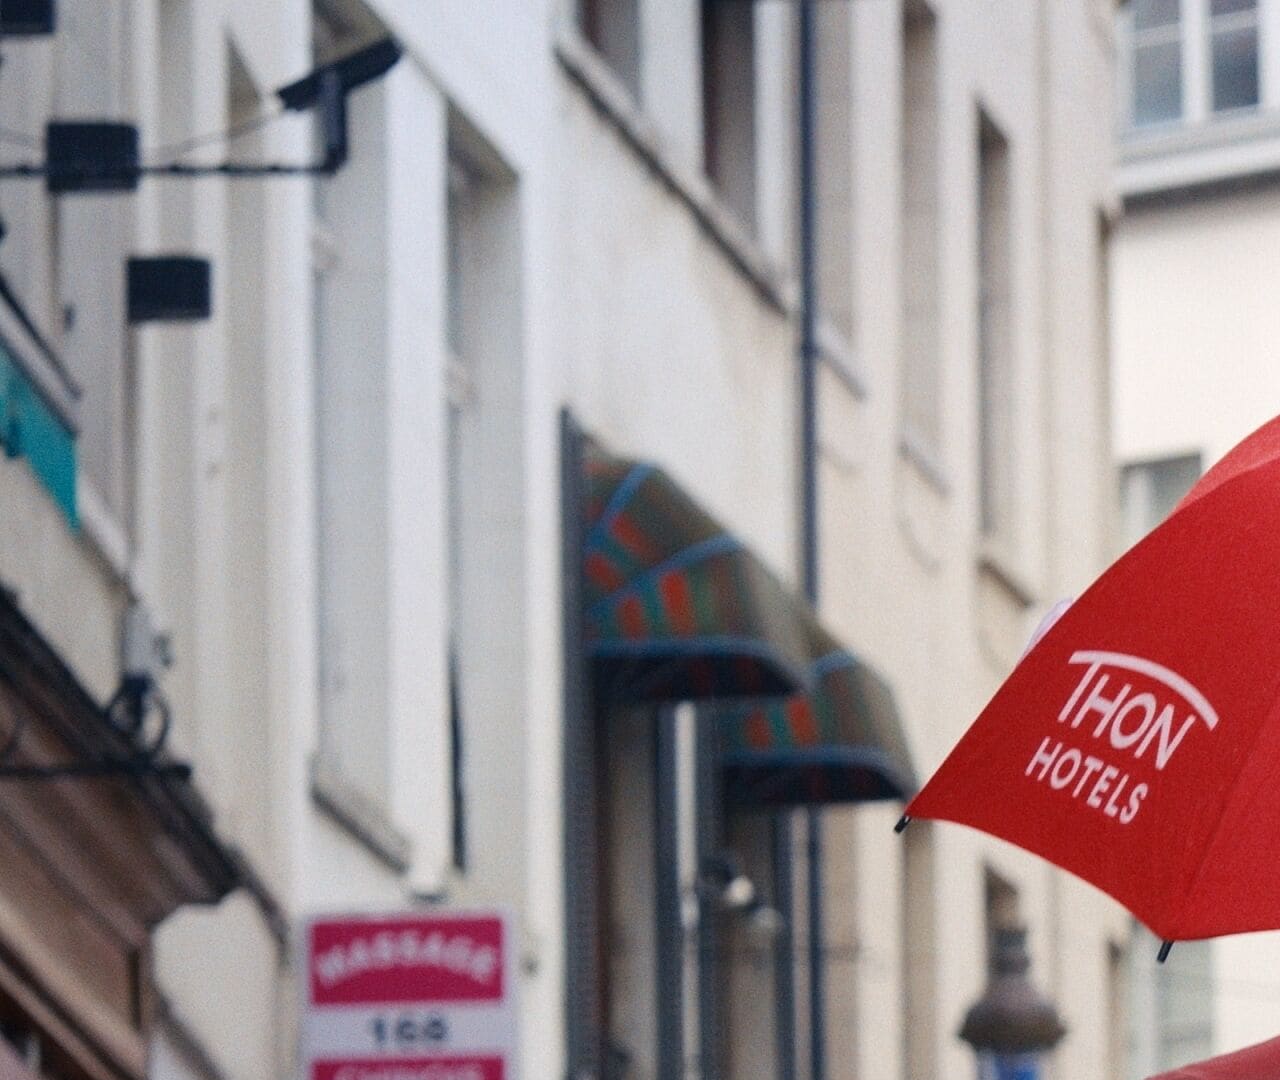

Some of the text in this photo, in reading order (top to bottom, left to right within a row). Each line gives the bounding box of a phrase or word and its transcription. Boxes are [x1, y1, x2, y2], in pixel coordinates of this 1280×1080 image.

[1058, 649, 1219, 771] THON
[1025, 735, 1149, 825] HOTELS
[317, 928, 495, 987] MASSAGE
